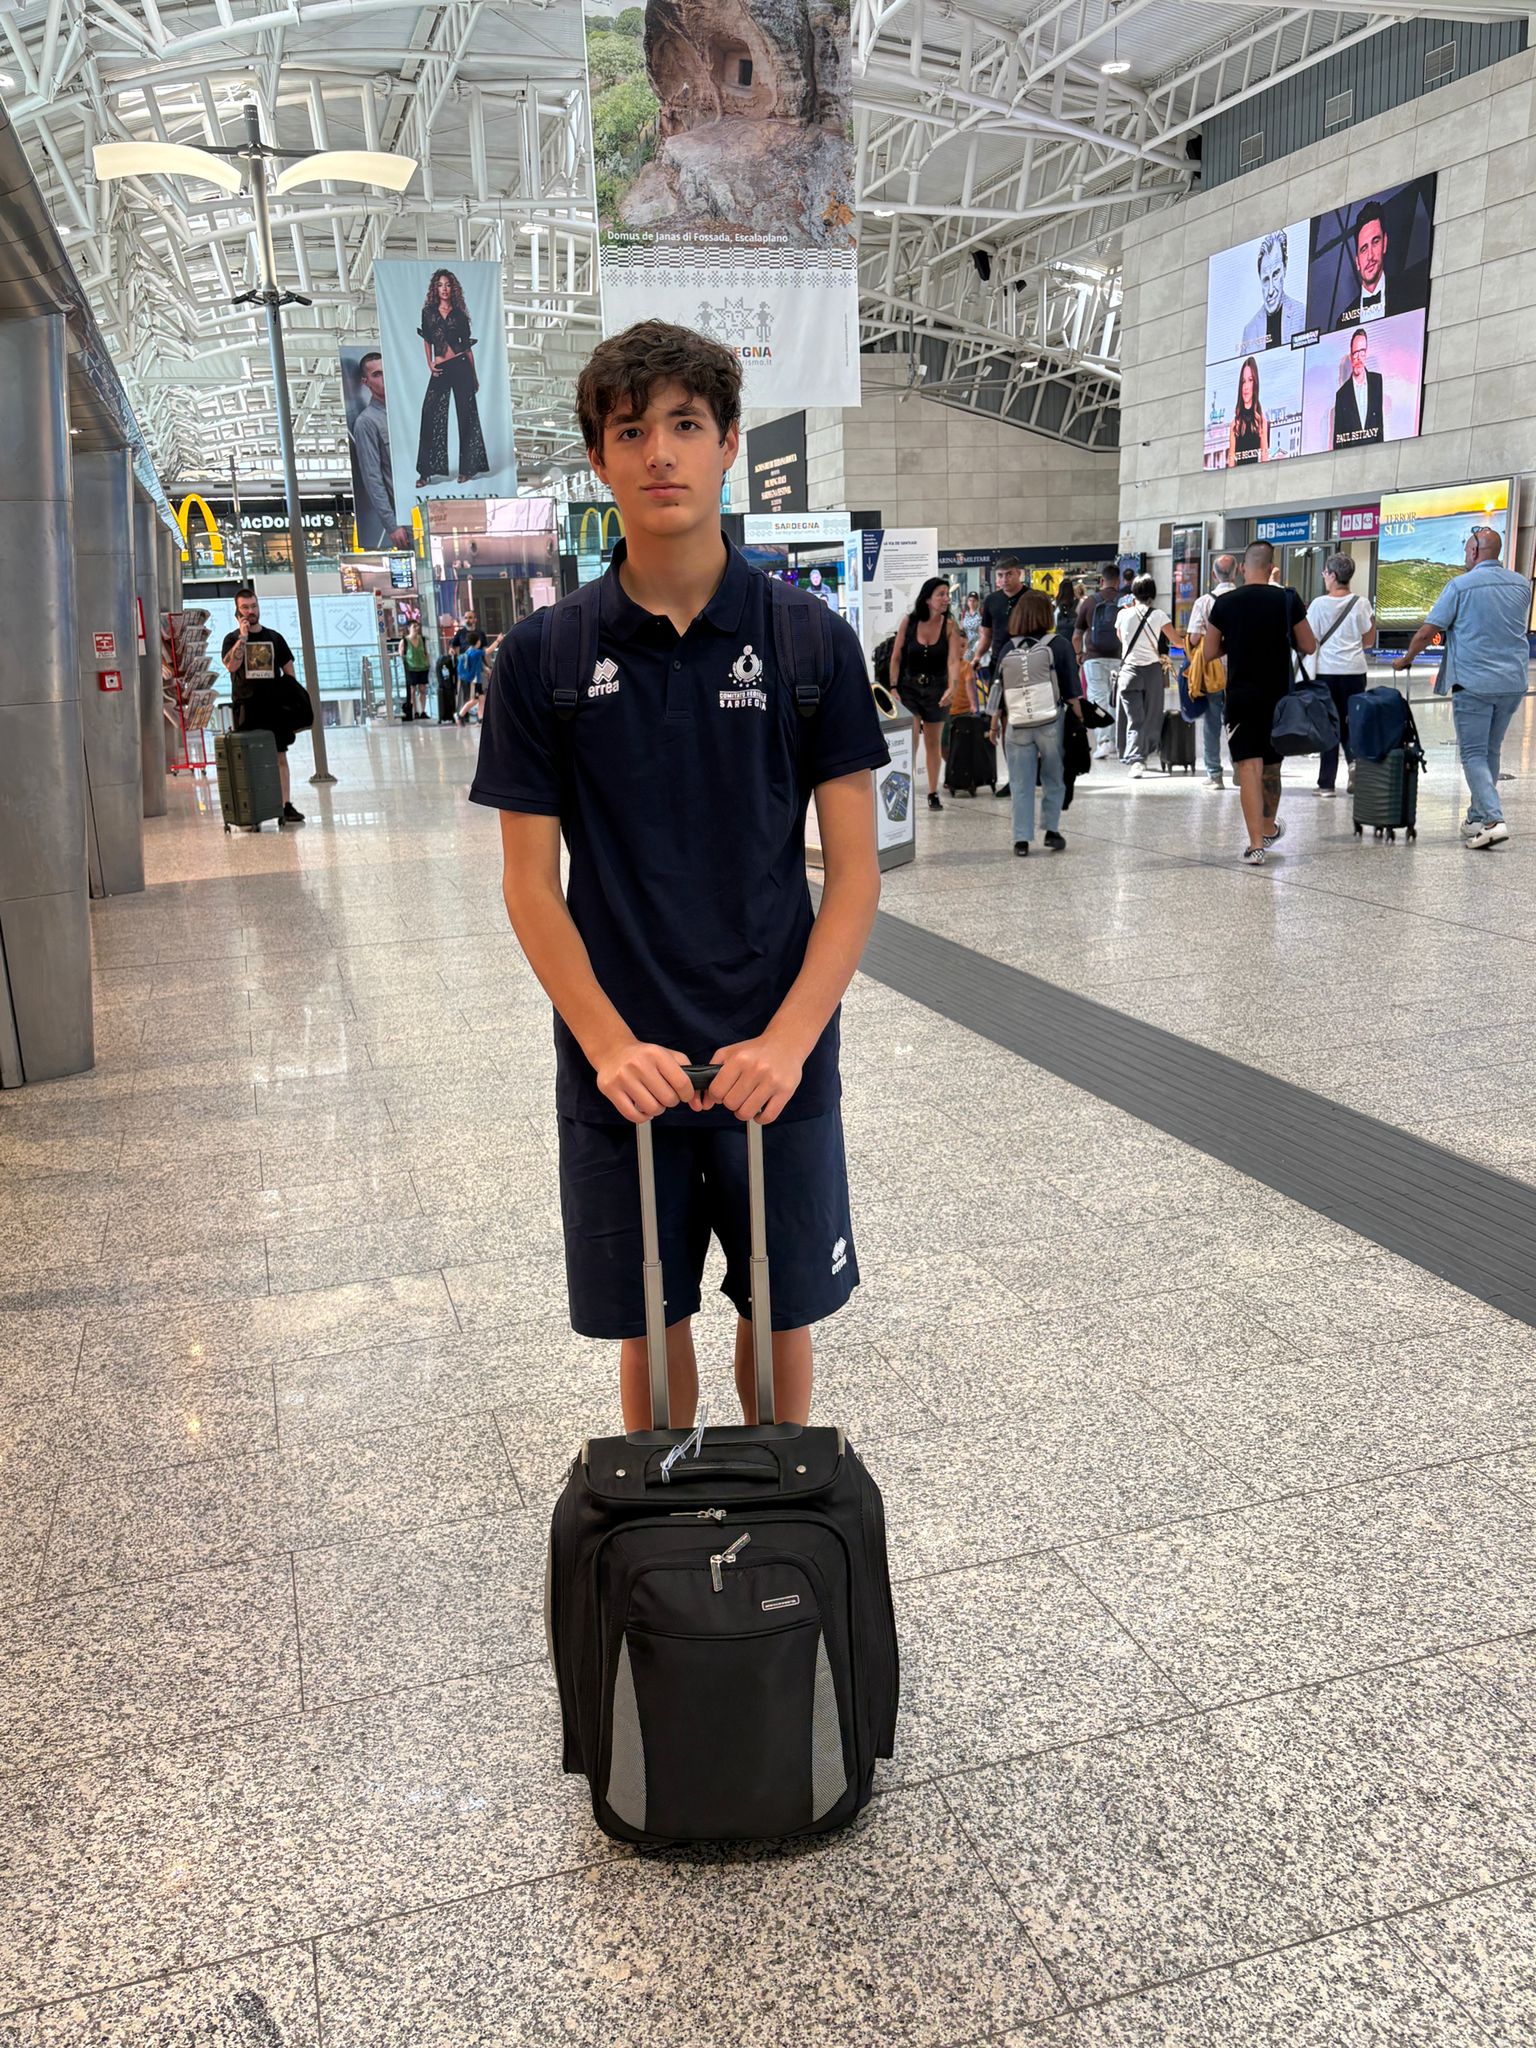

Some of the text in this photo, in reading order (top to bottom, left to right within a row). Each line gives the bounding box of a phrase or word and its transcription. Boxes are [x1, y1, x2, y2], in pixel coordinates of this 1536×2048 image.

[607, 230, 789, 244] Domus de Janas di Fossada, Escalaplano
[735, 346, 772, 358] EGNA
[1336, 431, 1350, 443] PAUL
[240, 513, 334, 530] McDold's
[774, 522, 820, 530] SARDEGNA
[1384, 522, 1416, 537] SULCIS
